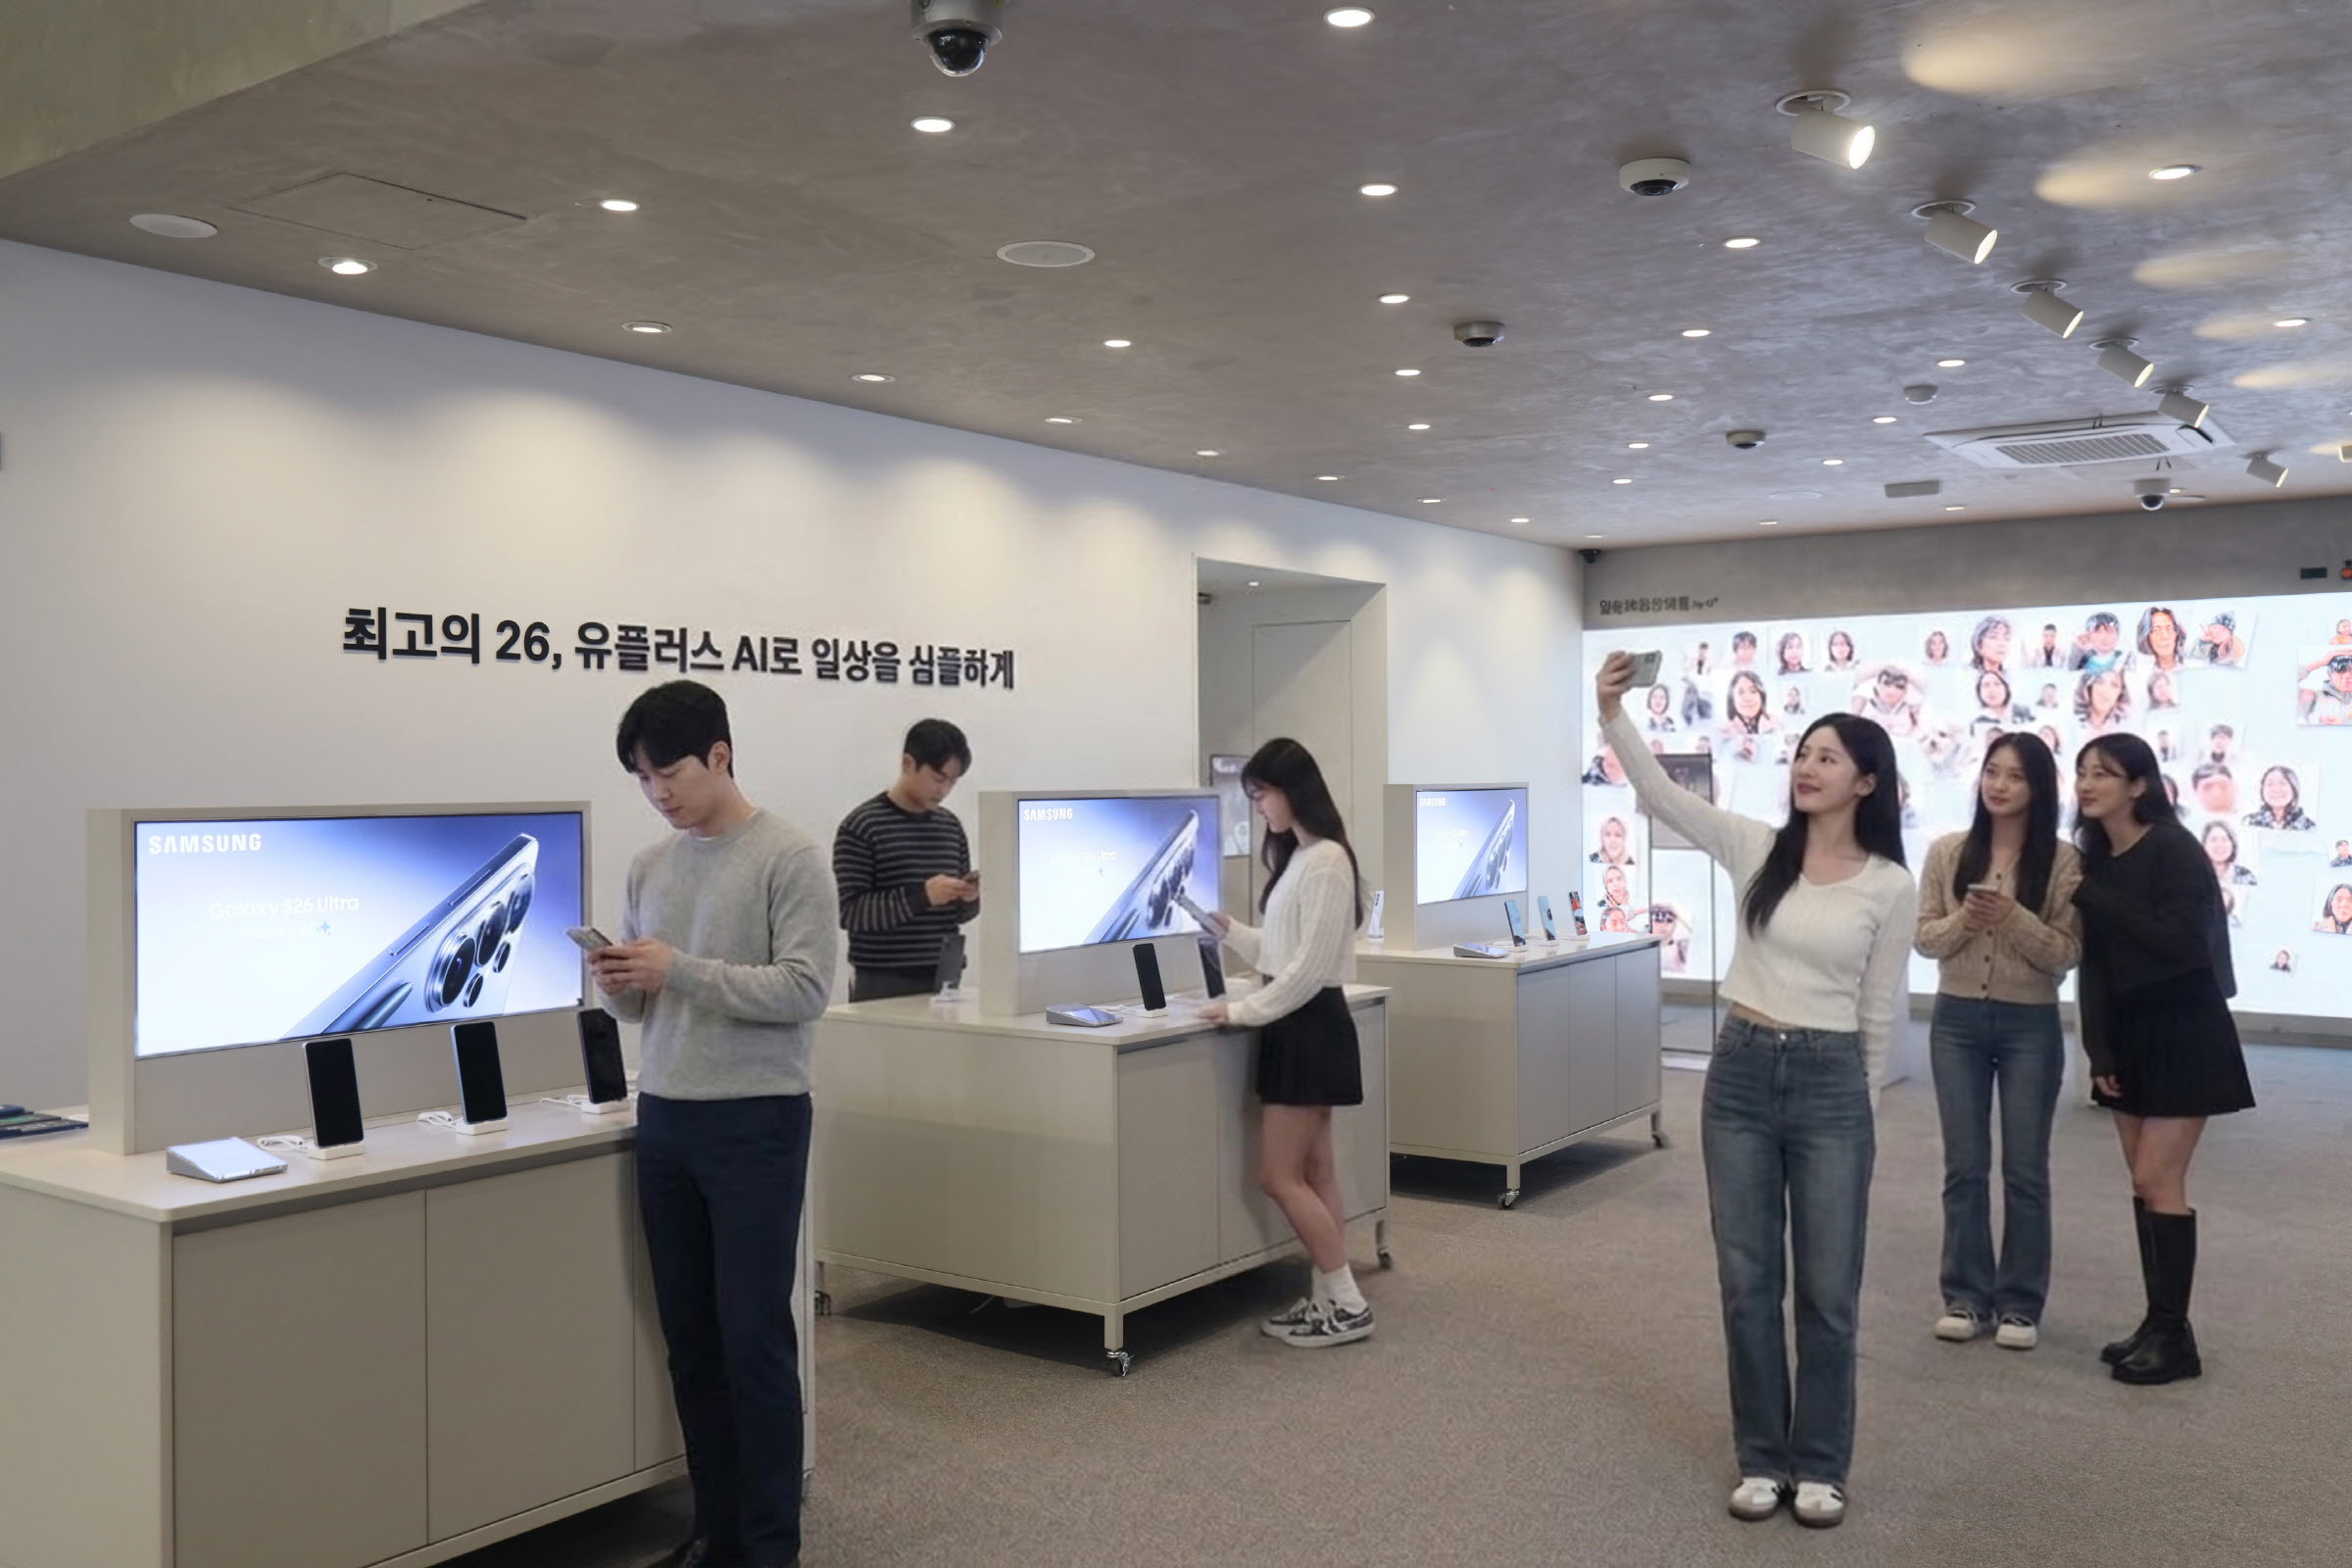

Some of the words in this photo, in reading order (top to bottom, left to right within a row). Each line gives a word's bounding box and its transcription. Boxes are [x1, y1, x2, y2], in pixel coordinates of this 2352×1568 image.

[343, 607, 480, 663] 최고의
[495, 619, 563, 670] 26,
[574, 621, 724, 673] 유플러스
[731, 636, 803, 674] AI로
[811, 638, 902, 683] 일상을
[908, 644, 1015, 690] 심플하게
[1023, 808, 1073, 822] SAMSUNG
[148, 833, 263, 855] SAMSUNG
[209, 901, 279, 919] Galaxy
[282, 897, 314, 915] S26
[317, 895, 360, 913] Ultra
